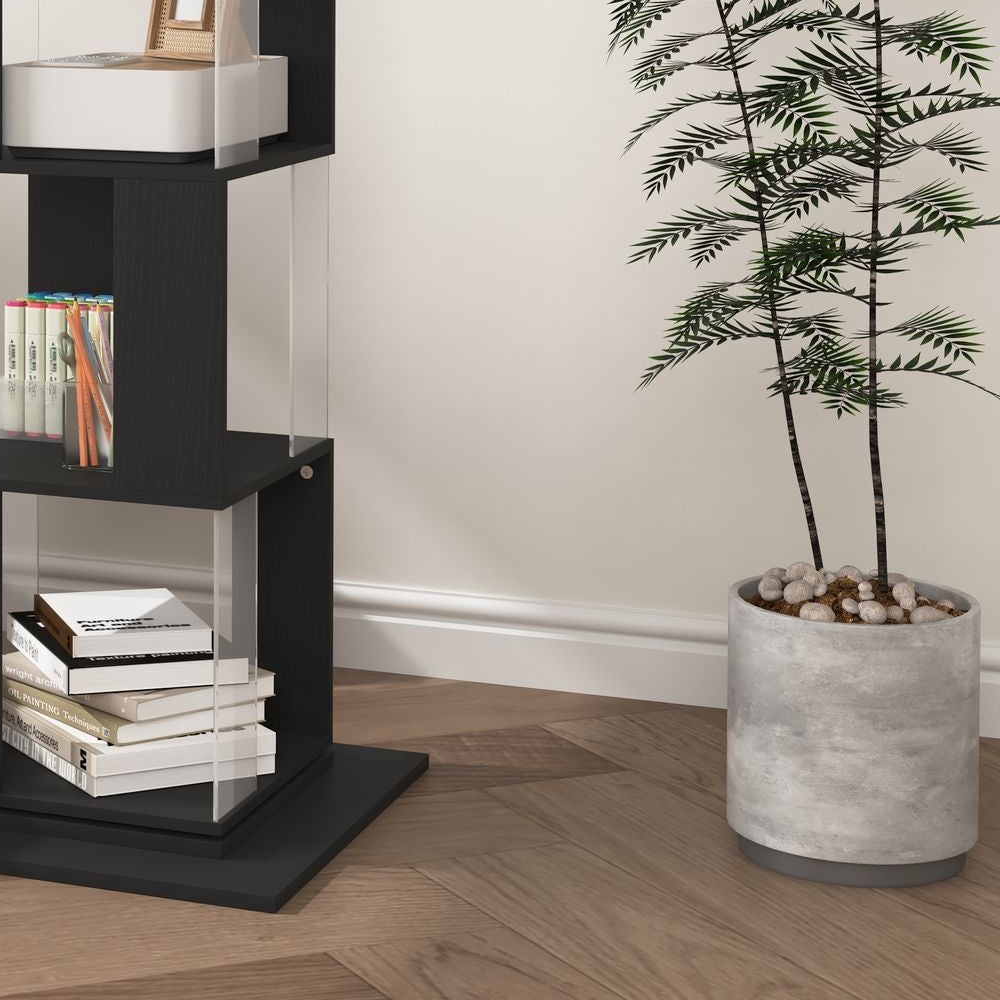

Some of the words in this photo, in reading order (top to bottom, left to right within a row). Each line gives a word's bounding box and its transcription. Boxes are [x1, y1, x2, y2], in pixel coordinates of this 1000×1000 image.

[5, 665, 33, 682] wright
[8, 687, 22, 702] OIL
[22, 694, 60, 716] PAINTING
[63, 710, 100, 733] Techniques
[80, 748, 87, 771] M
